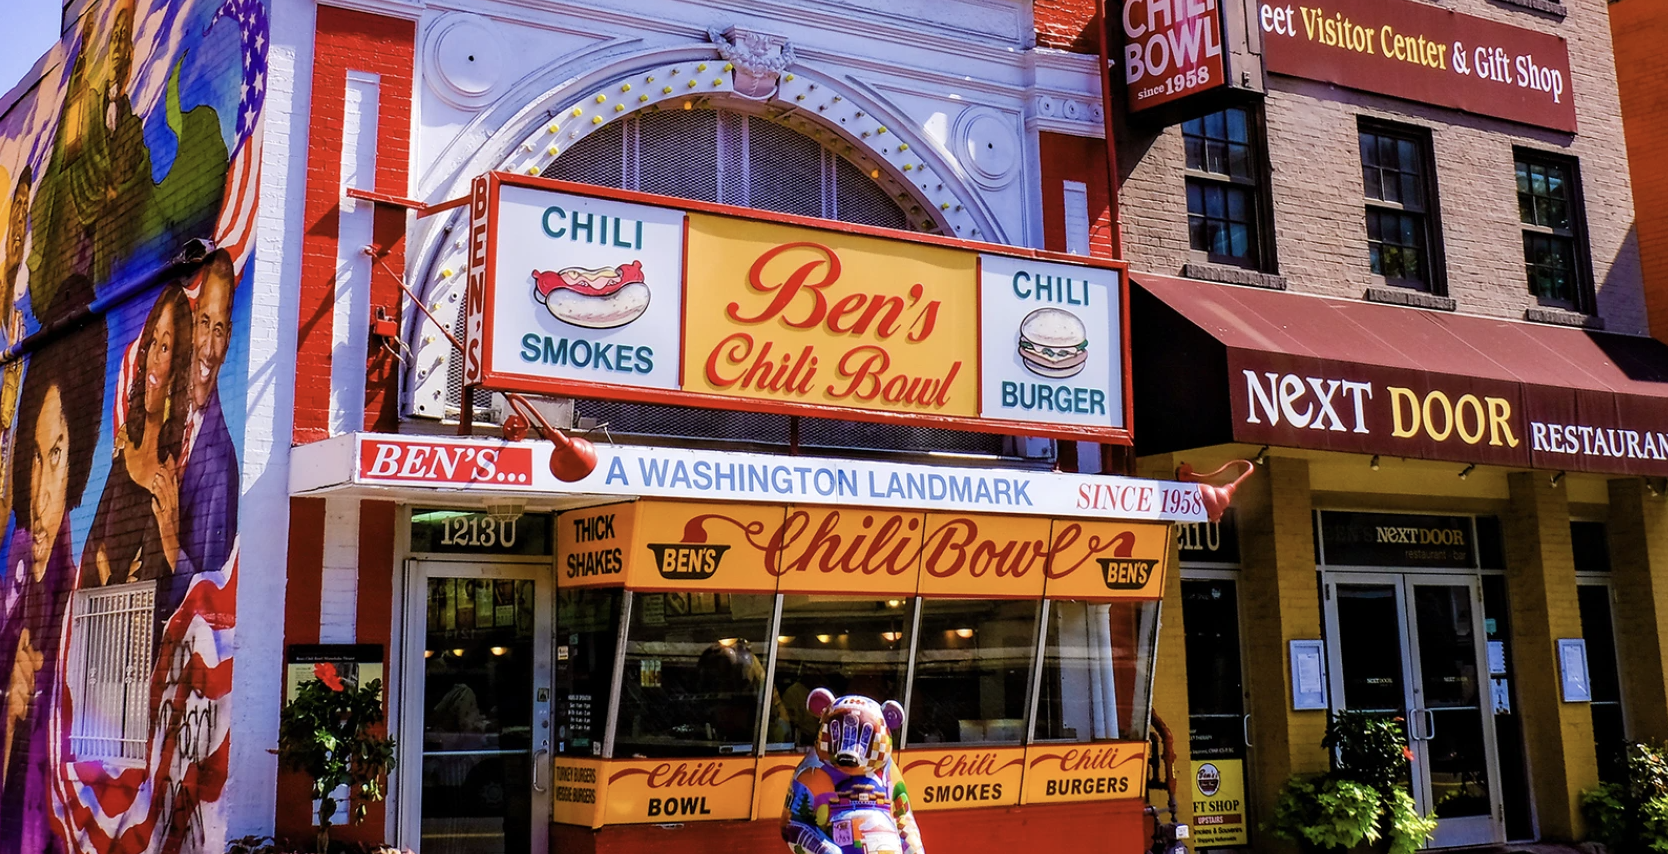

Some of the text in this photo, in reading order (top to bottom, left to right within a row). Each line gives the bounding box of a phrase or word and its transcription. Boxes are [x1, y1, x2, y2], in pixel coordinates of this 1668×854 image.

[1123, 0, 1215, 38] CHIL
[1124, 16, 1221, 85] BOWL
[1261, 3, 1564, 103] eet Visitor Center & Gift Shop
[1137, 66, 1210, 100] since 1958
[541, 205, 643, 250] CHILI
[467, 178, 487, 379] BEN'S
[727, 241, 941, 343] Ben's
[1013, 270, 1090, 306] CHILI
[521, 333, 654, 374] SMOKES
[705, 332, 962, 407] Chili Bowl
[1002, 380, 1106, 415] BURGER
[1386, 386, 1519, 448] DOOR
[367, 442, 527, 483] BEN'S...
[605, 455, 1034, 507] A WASHINGTON LANDMARK
[1076, 483, 1202, 515] SINCE 1958
[440, 516, 496, 547] 1213
[573, 514, 616, 543] THICK
[1420, 528, 1466, 545] DOOR
[764, 510, 1085, 579] Chili Bowl
[1405, 549, 1466, 561] restaurant bar
[567, 549, 622, 578] SHAKES
[662, 547, 717, 574] BEN'S
[1107, 562, 1149, 584] BEN'S
[647, 761, 724, 788] Chili
[934, 752, 997, 780] Chili
[1060, 747, 1120, 772] Chili
[574, 767, 596, 784] BURGERS
[1045, 776, 1129, 796] BURGERS
[573, 787, 596, 804] BURGERS
[648, 796, 711, 816] BOWL
[923, 782, 1003, 803] SMOKES
[1193, 799, 1240, 813] FT SHOP
[1197, 815, 1223, 825] UPSTAIRS
